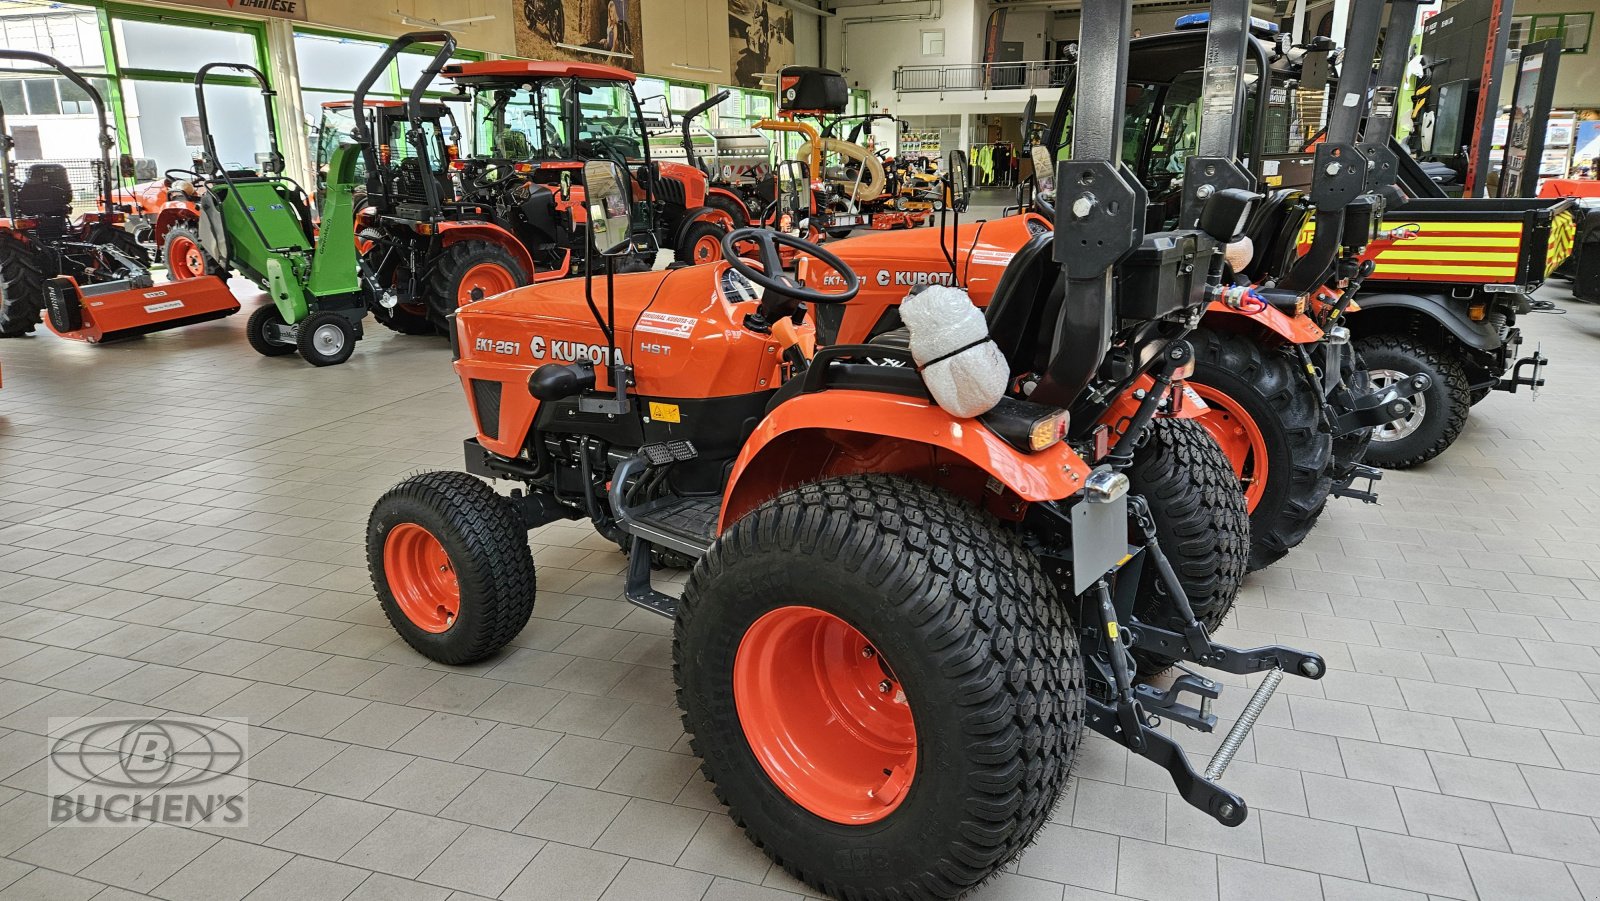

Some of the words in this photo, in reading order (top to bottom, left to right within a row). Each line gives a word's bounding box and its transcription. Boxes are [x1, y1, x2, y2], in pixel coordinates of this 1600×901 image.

[475, 338, 520, 356] EK1-261
[551, 339, 625, 366] KUBOTA
[641, 342, 671, 356] HST
